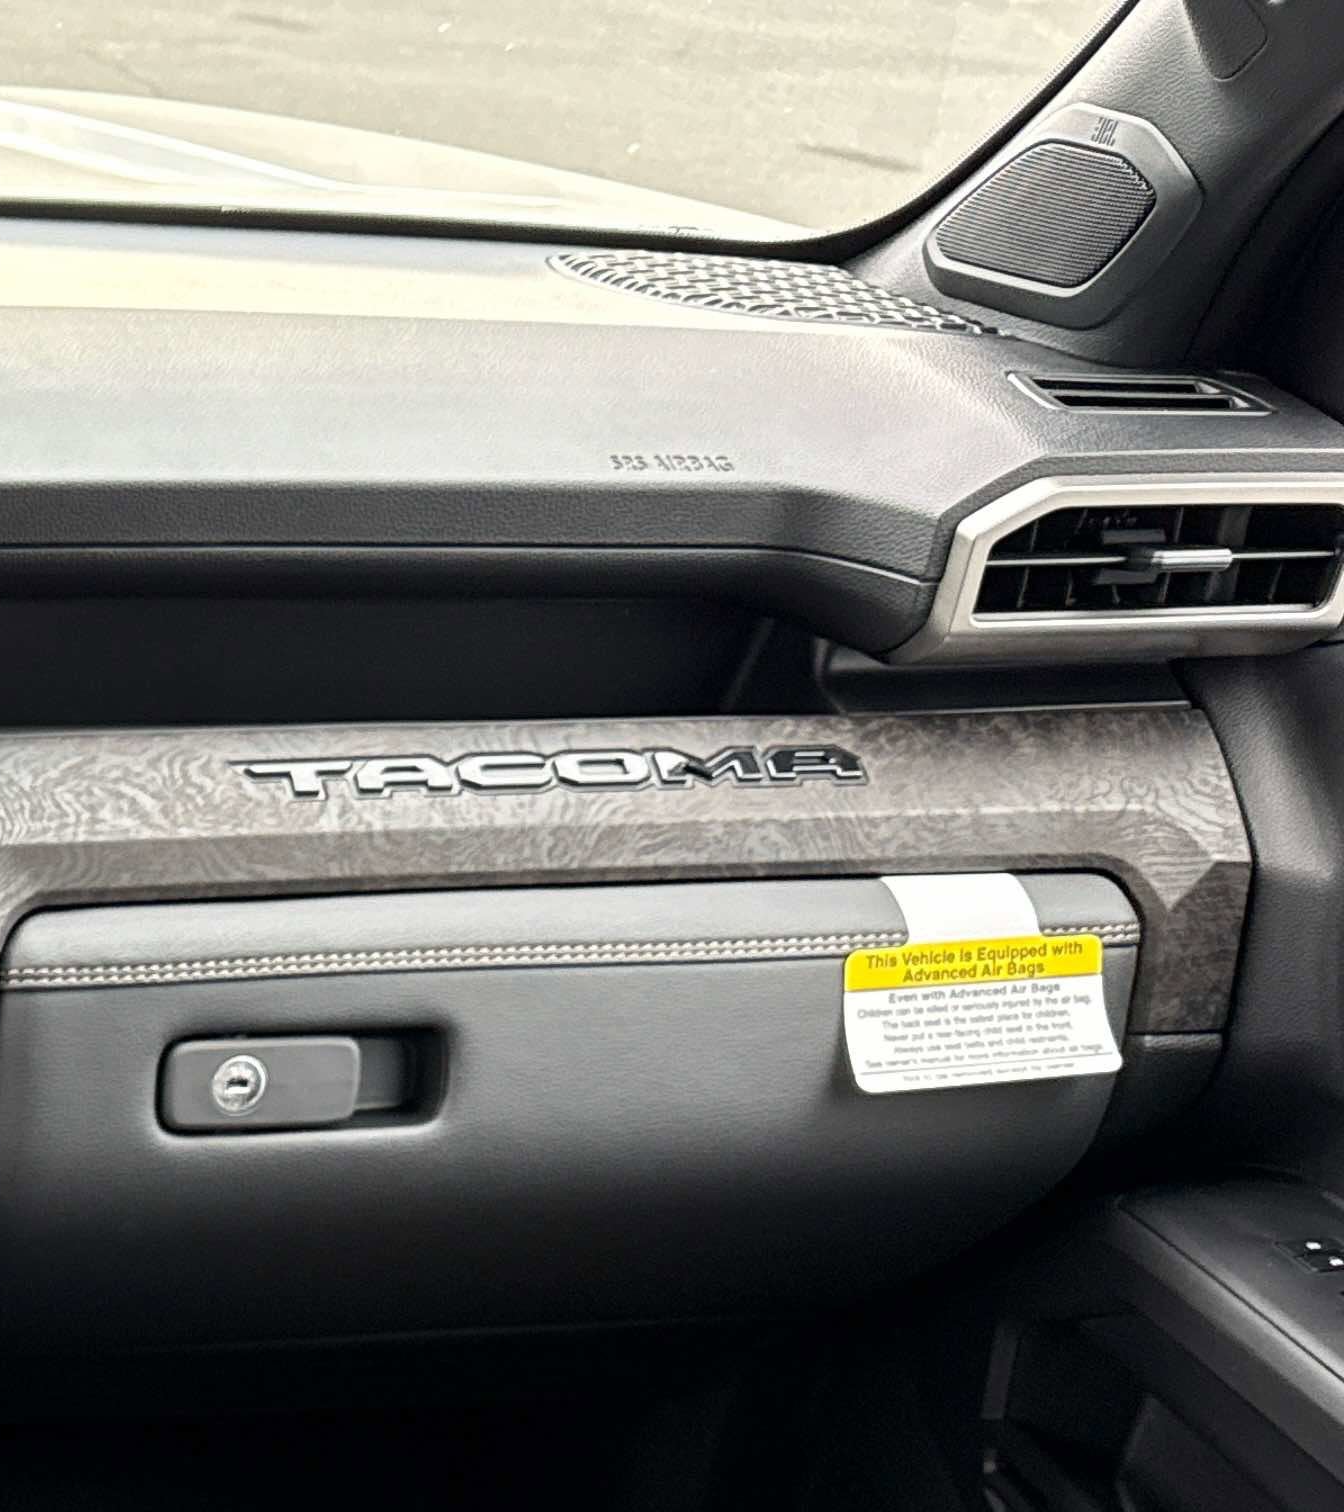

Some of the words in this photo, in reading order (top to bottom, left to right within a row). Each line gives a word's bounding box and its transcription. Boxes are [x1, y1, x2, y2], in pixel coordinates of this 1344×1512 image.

[227, 744, 868, 800] TACOMA
[866, 954, 897, 969] This
[902, 951, 955, 967] Vehicle
[959, 948, 973, 962] is
[977, 944, 1048, 964] Equipped
[1051, 941, 1083, 956] with
[902, 966, 977, 983] Advanced
[981, 963, 1002, 977] Air
[1006, 961, 1045, 979] Bags
[889, 993, 918, 1004] Even
[921, 990, 946, 1001] with
[949, 985, 1007, 999] Advanced
[1011, 984, 1027, 995] Air
[1030, 982, 1061, 994] Bags
